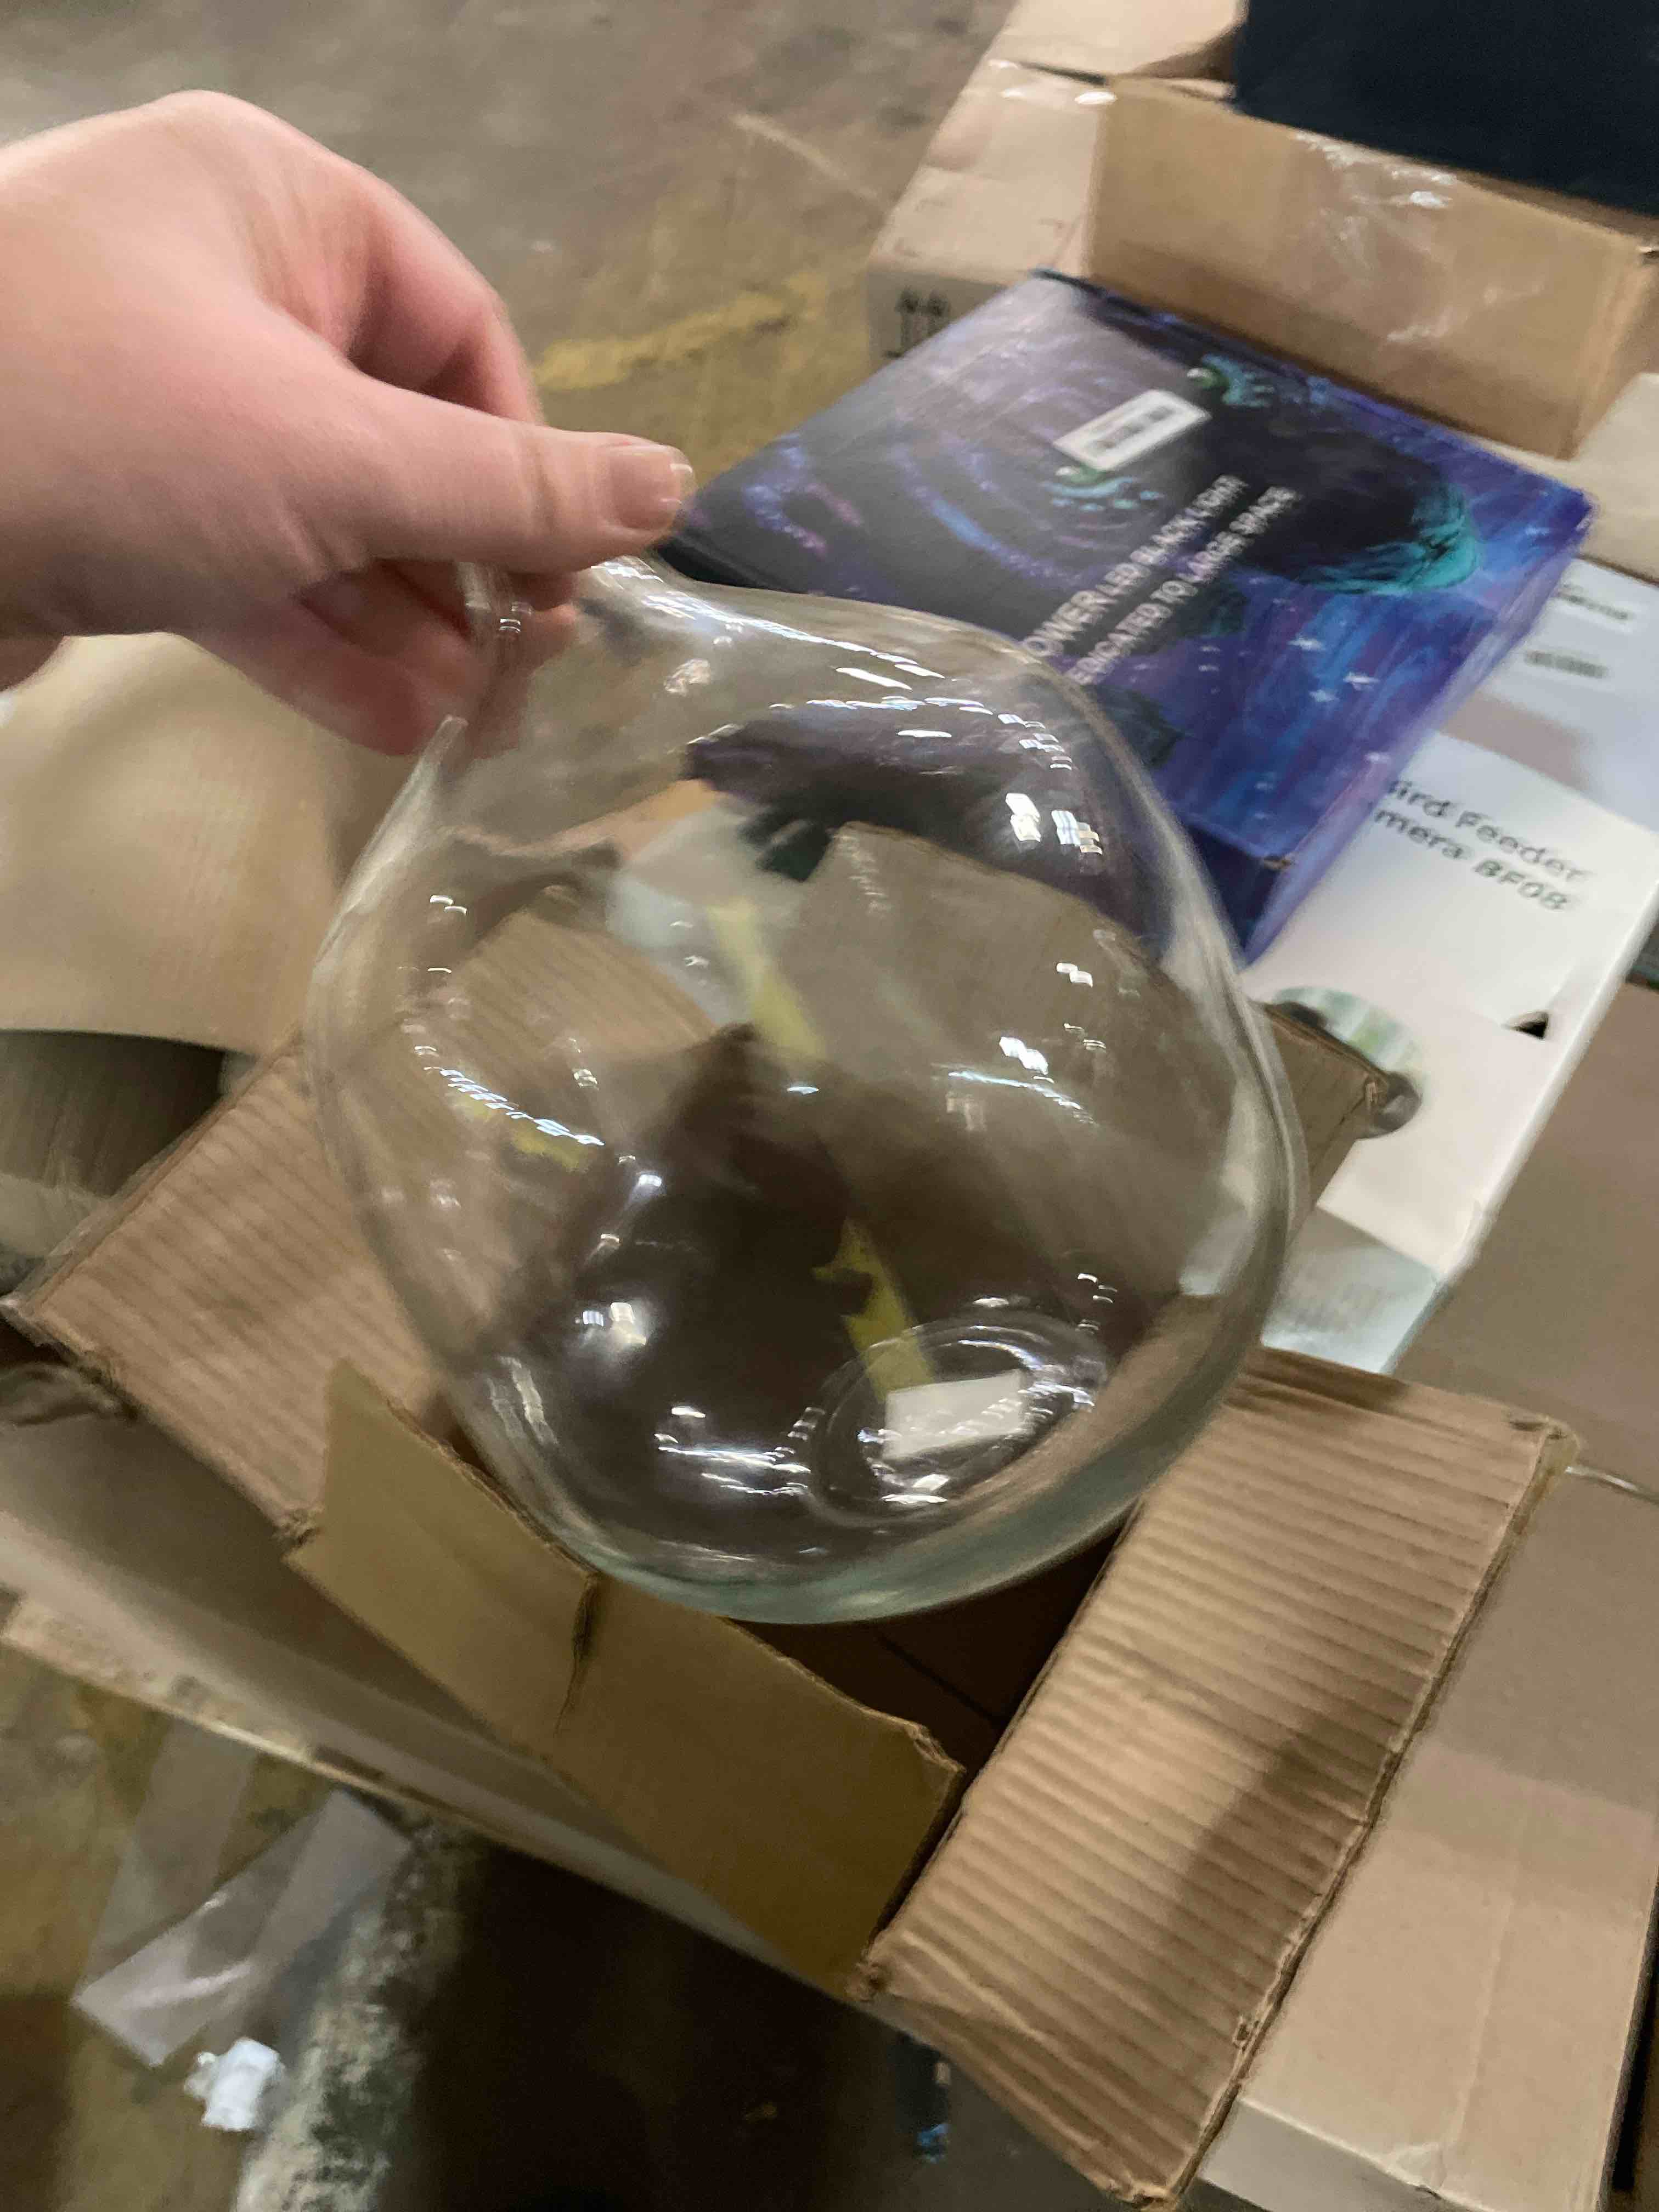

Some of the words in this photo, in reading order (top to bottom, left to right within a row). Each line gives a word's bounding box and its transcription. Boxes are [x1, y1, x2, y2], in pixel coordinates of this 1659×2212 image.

[1020, 590, 1118, 657] OWER
[1095, 563, 1151, 596] LED
[1130, 514, 1206, 566] BLACK
[1064, 603, 1173, 685] EDICATED
[1150, 580, 1199, 603] TO
[1176, 531, 1255, 584] LARGE
[1229, 487, 1300, 535] SPACE
[1455, 810, 1591, 882] Feeder
